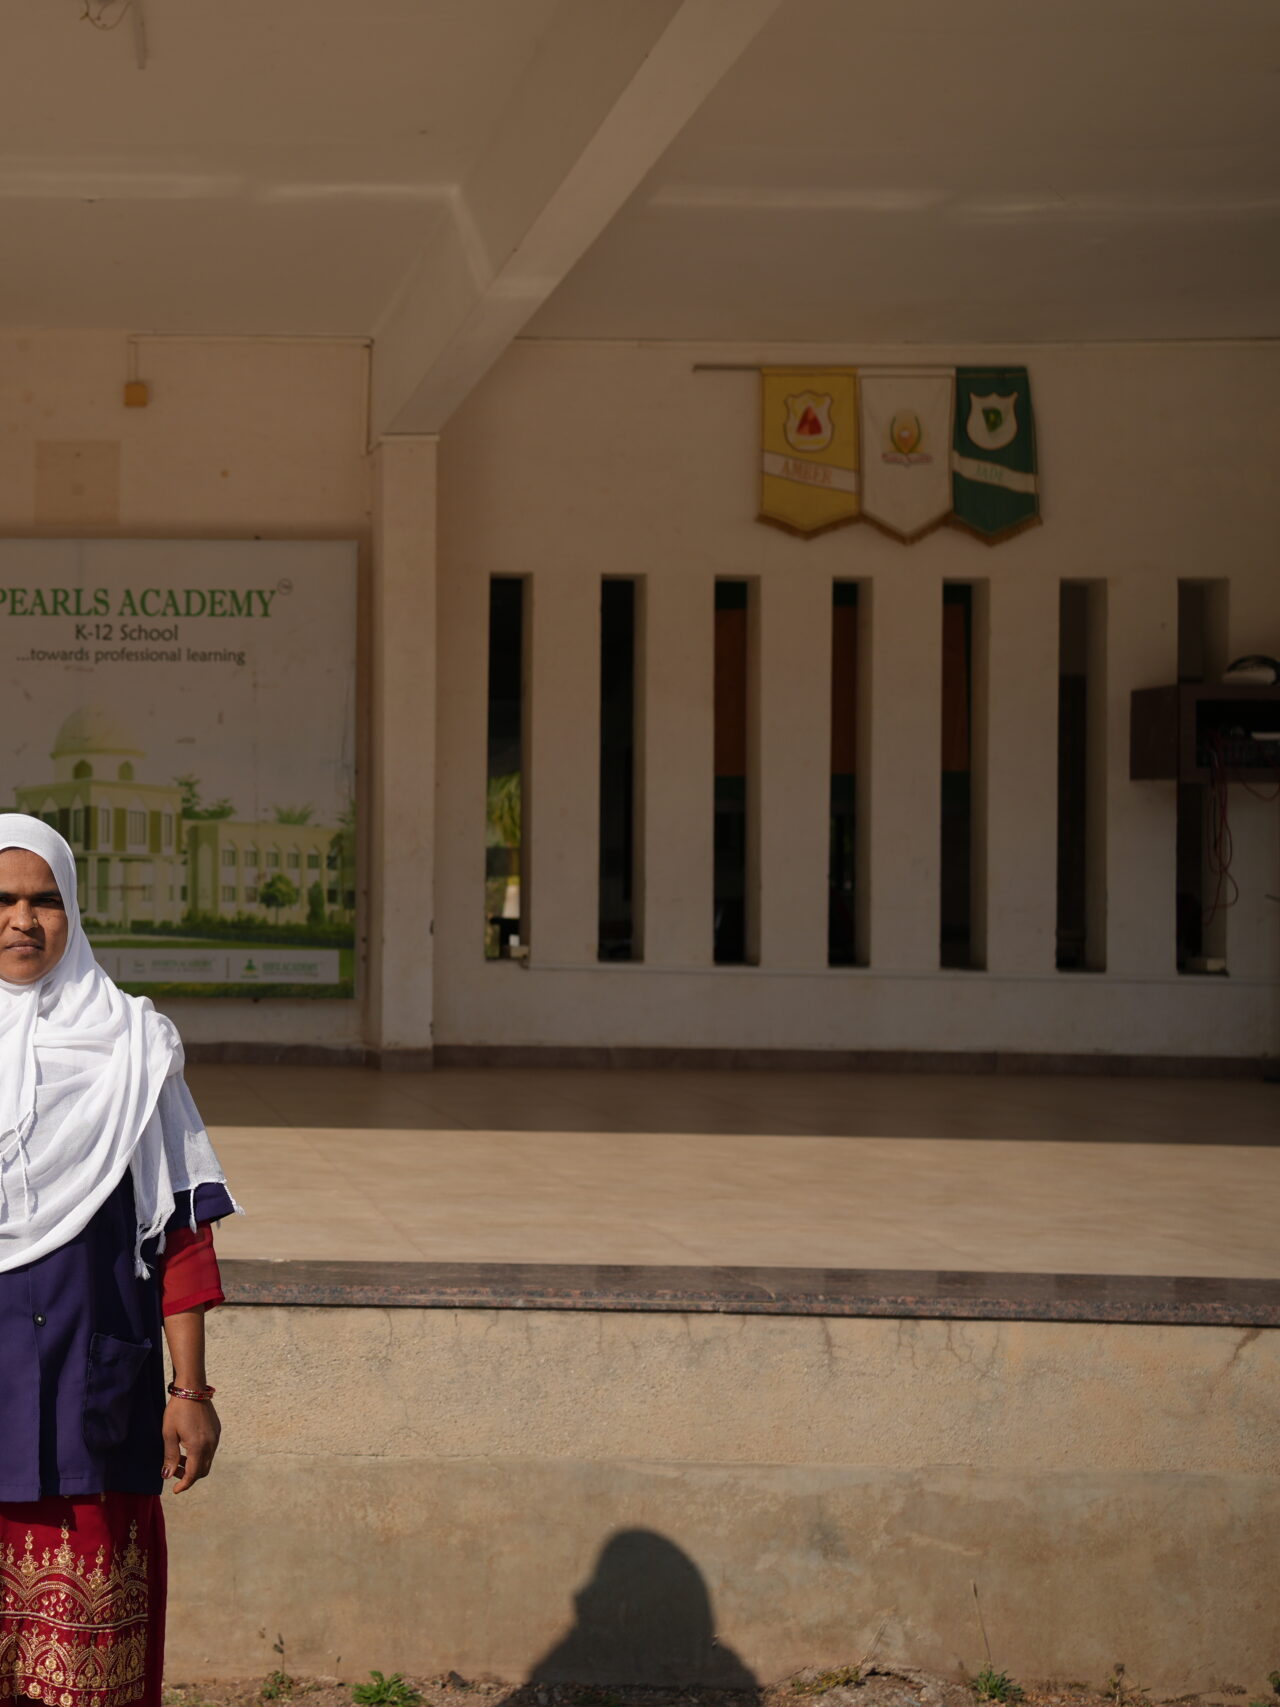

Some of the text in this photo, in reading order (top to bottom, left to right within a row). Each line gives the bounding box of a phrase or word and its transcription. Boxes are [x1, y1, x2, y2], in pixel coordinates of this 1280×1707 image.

[782, 459, 832, 484] AMBER
[118, 588, 276, 618] ACADEMY
[75, 624, 178, 641] K-12 School
[16, 647, 246, 665] ...towards professional learning
